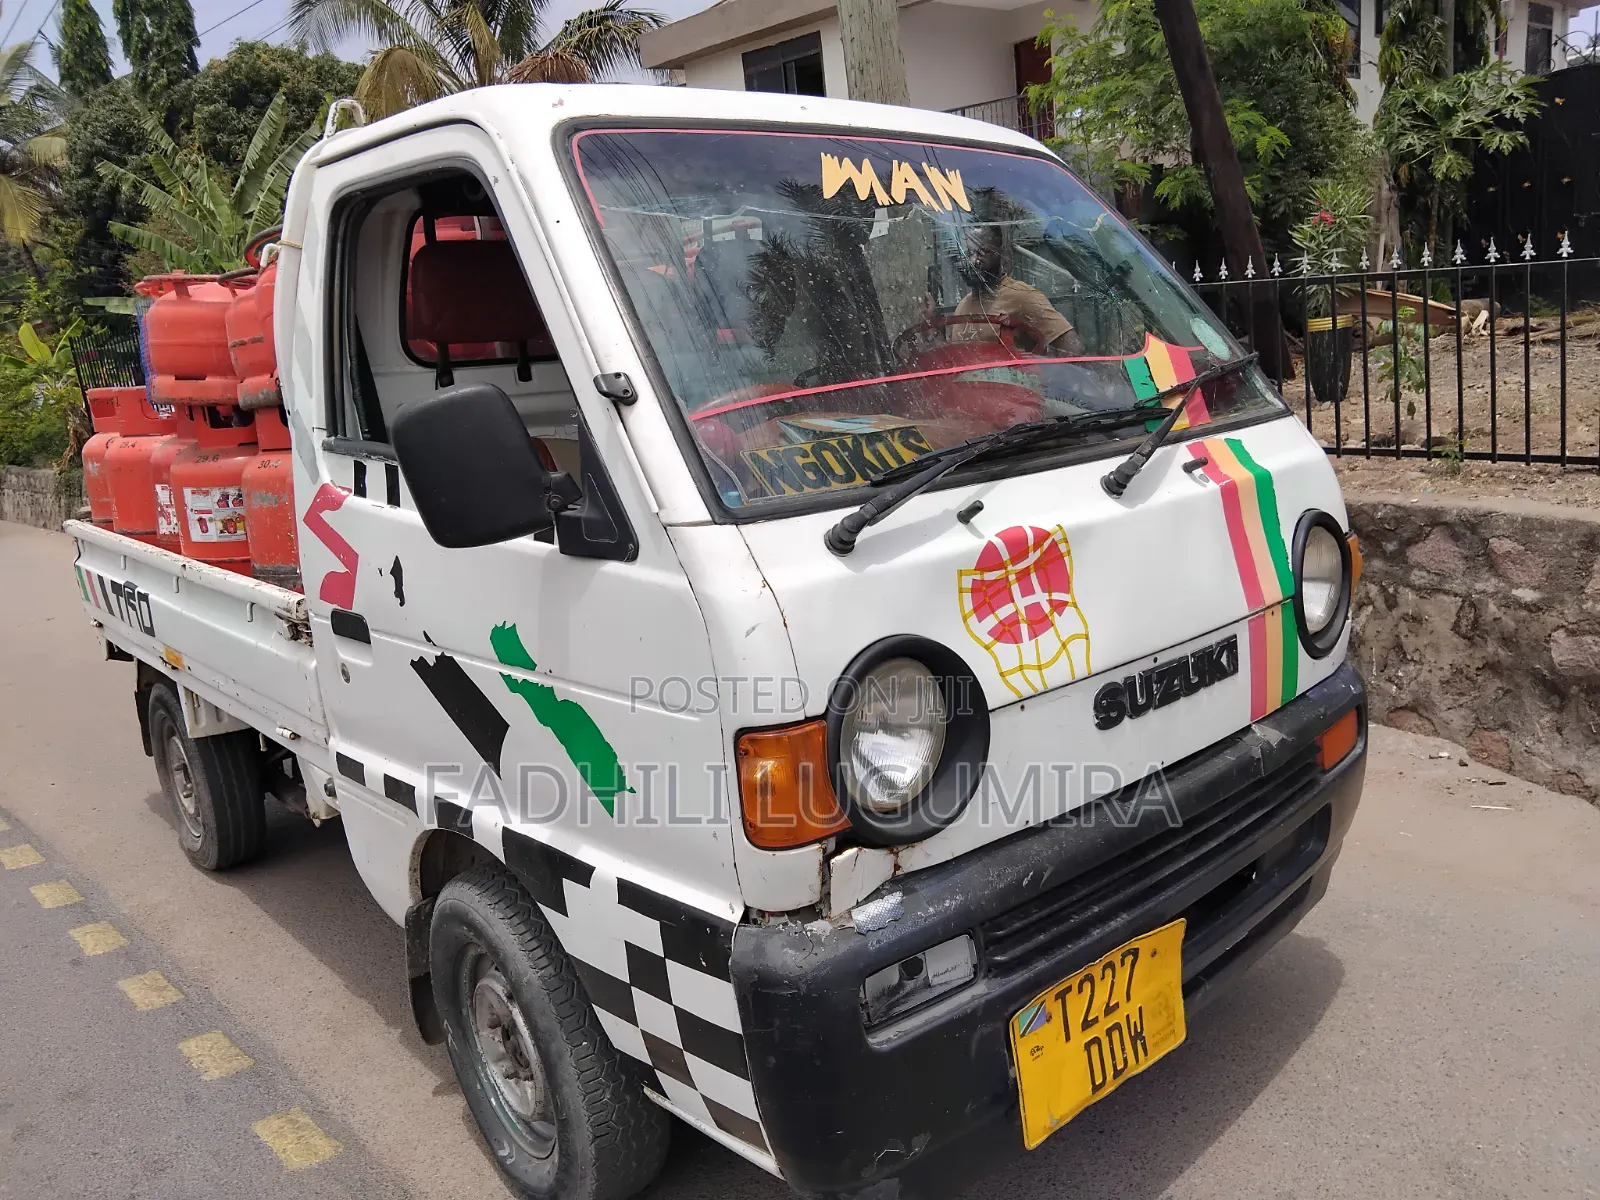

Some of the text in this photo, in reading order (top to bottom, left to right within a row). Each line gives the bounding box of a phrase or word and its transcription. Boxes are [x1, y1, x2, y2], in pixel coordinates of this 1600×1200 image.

[820, 151, 972, 214] MAN
[195, 454, 220, 464] 29.6
[1092, 633, 1239, 731] SUZUKI
[1054, 947, 1140, 1043] T227
[1083, 1005, 1149, 1096] DDW
